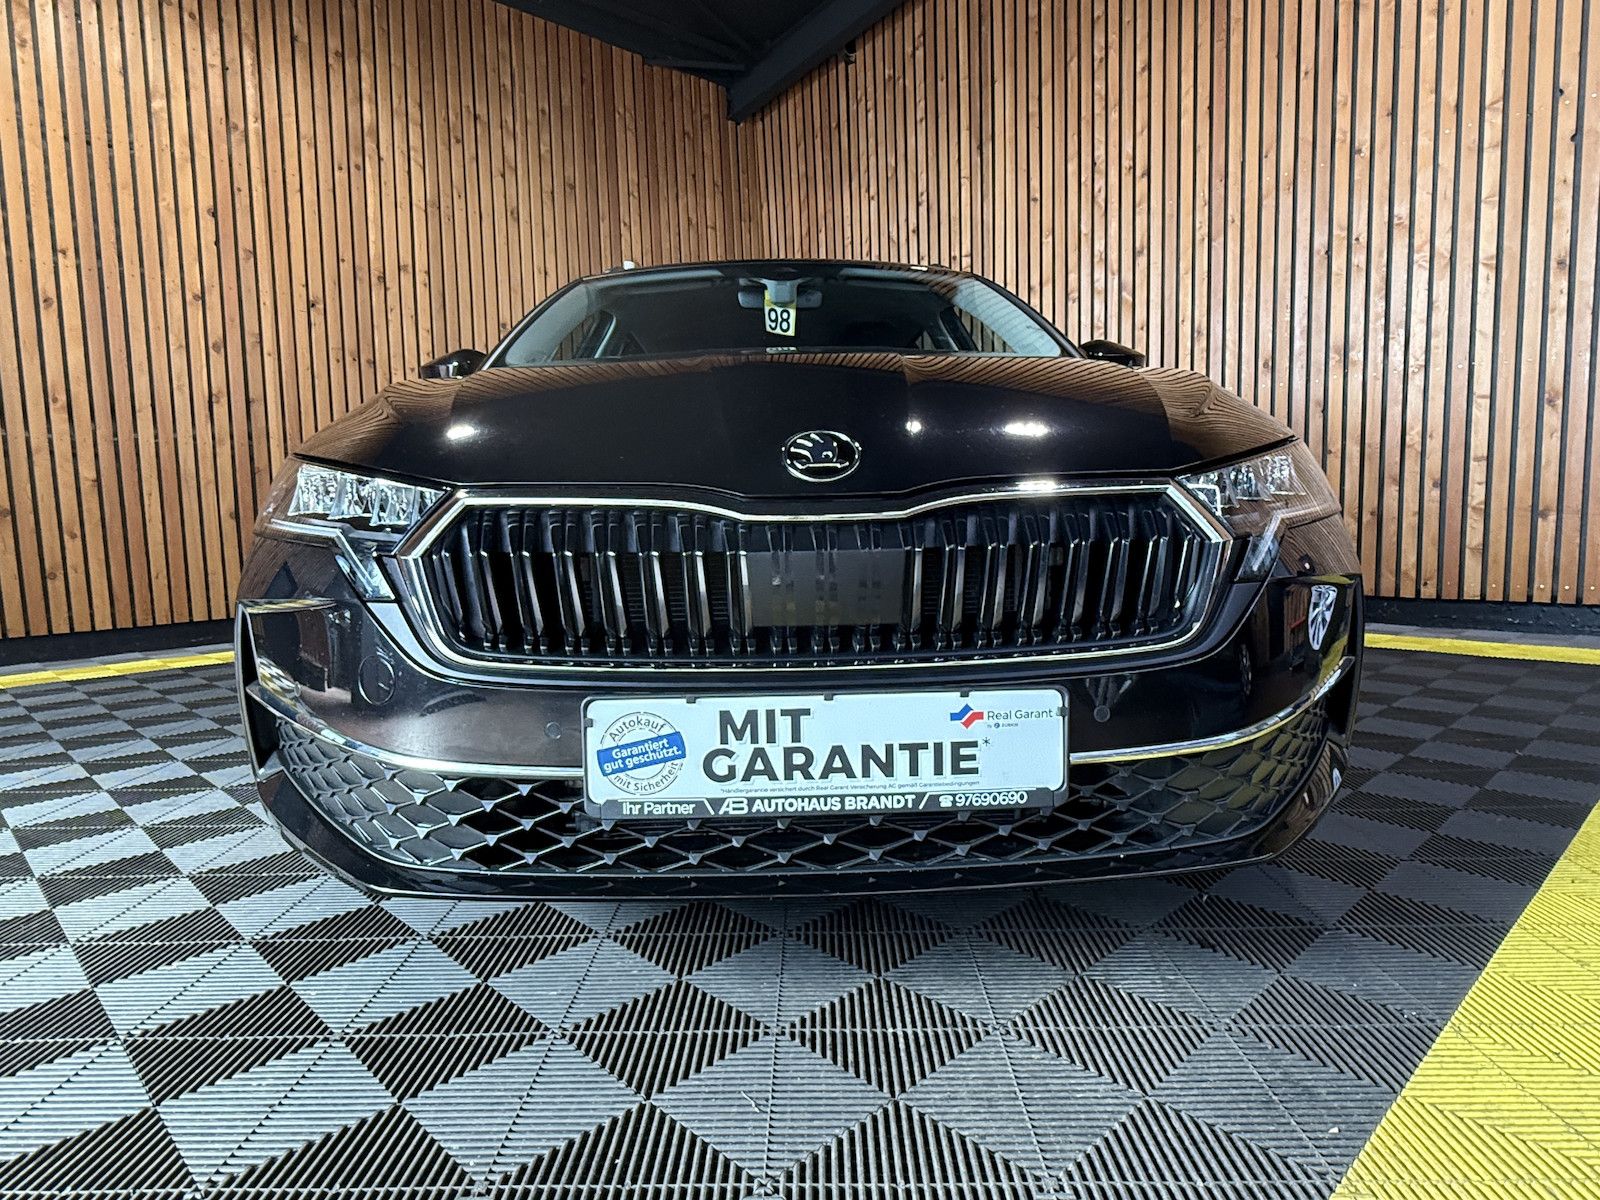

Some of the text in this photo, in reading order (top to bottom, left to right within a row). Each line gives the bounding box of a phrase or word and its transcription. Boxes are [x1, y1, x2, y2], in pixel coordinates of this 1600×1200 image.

[768, 308, 790, 333] 98
[719, 708, 811, 745] MIT
[987, 709, 1053, 720] Real Garant
[609, 715, 667, 742] Autokauf
[603, 746, 682, 773] gut geschützt.
[612, 738, 669, 759] Garantiert
[614, 762, 679, 792] mit Sicherheit
[622, 801, 641, 815] Ihr
[643, 802, 696, 815] Partner
[752, 796, 842, 813] AUTOHAUS
[844, 794, 916, 810] BRANDT
[955, 791, 1028, 807] 97690690
